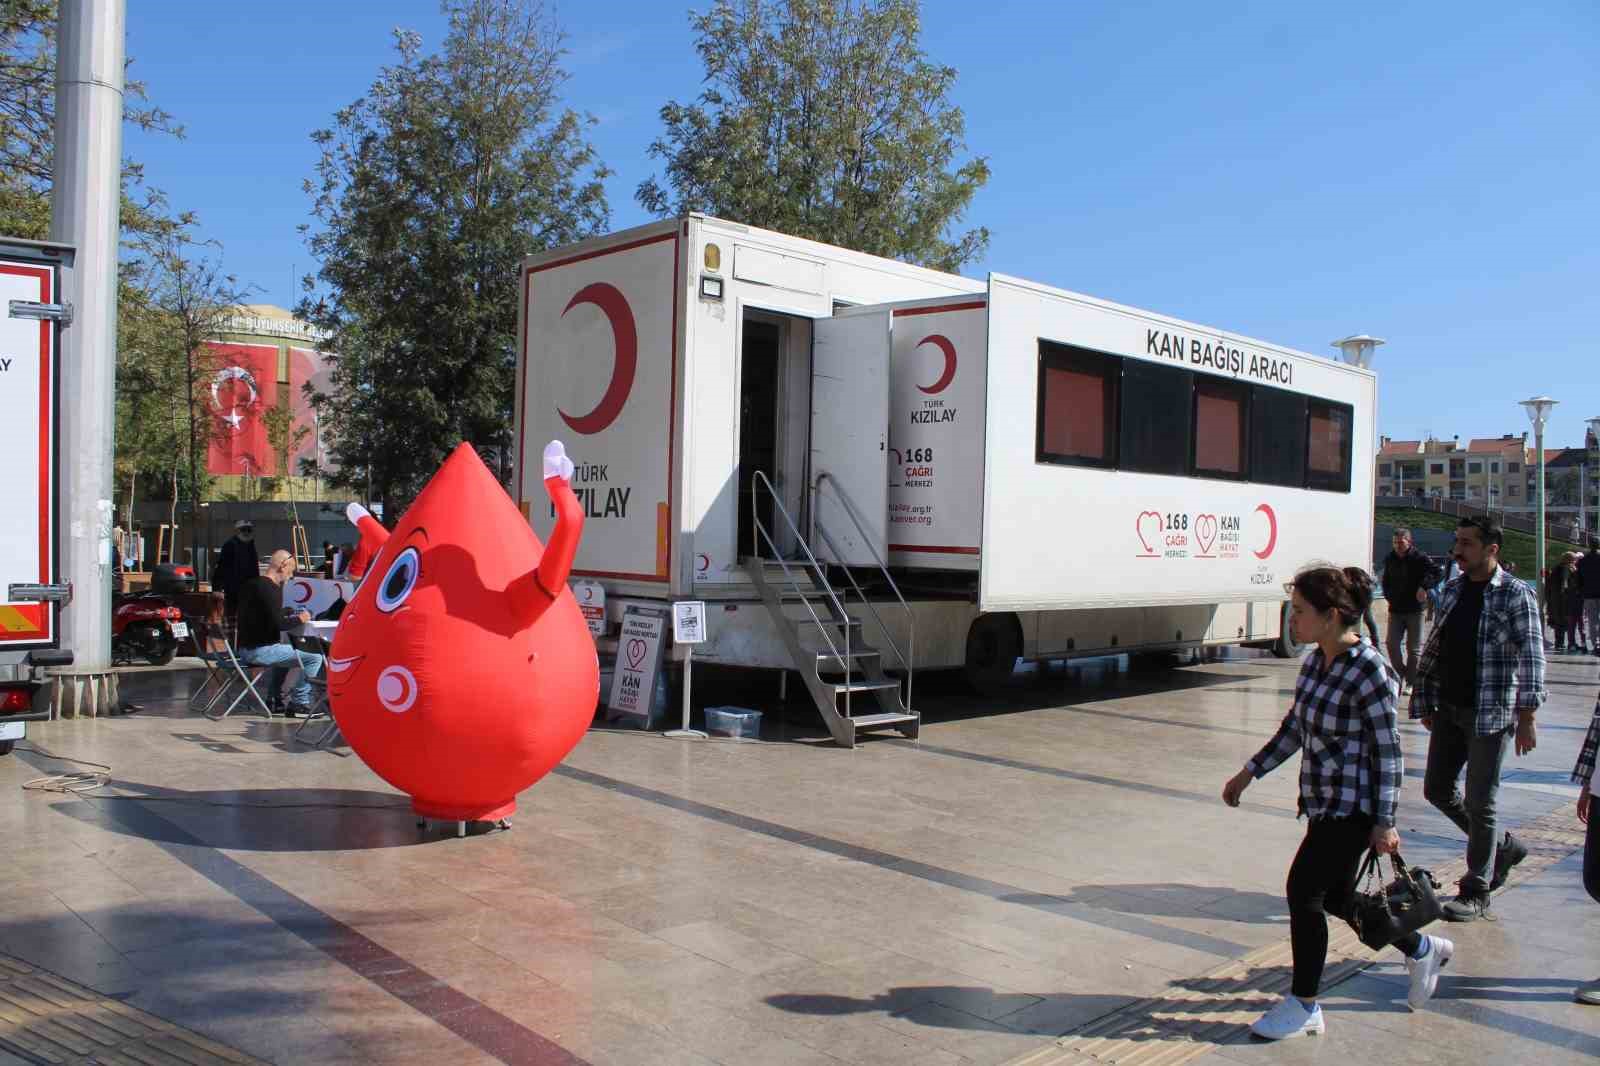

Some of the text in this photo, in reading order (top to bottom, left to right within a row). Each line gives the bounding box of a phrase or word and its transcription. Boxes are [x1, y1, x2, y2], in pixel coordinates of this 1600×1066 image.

[1147, 328, 1293, 385] KAN BAĞIŞI ARACI
[924, 399, 945, 408] TÜRK
[911, 408, 957, 424] KIZILAY
[905, 448, 933, 463] 168
[574, 461, 609, 482] TÜRK
[905, 466, 933, 479] ÇAĞRI
[1165, 512, 1189, 530] 168
[1220, 516, 1241, 531] KAN
[1165, 533, 1188, 547] ÇAĞRI
[622, 673, 641, 689] KAN
